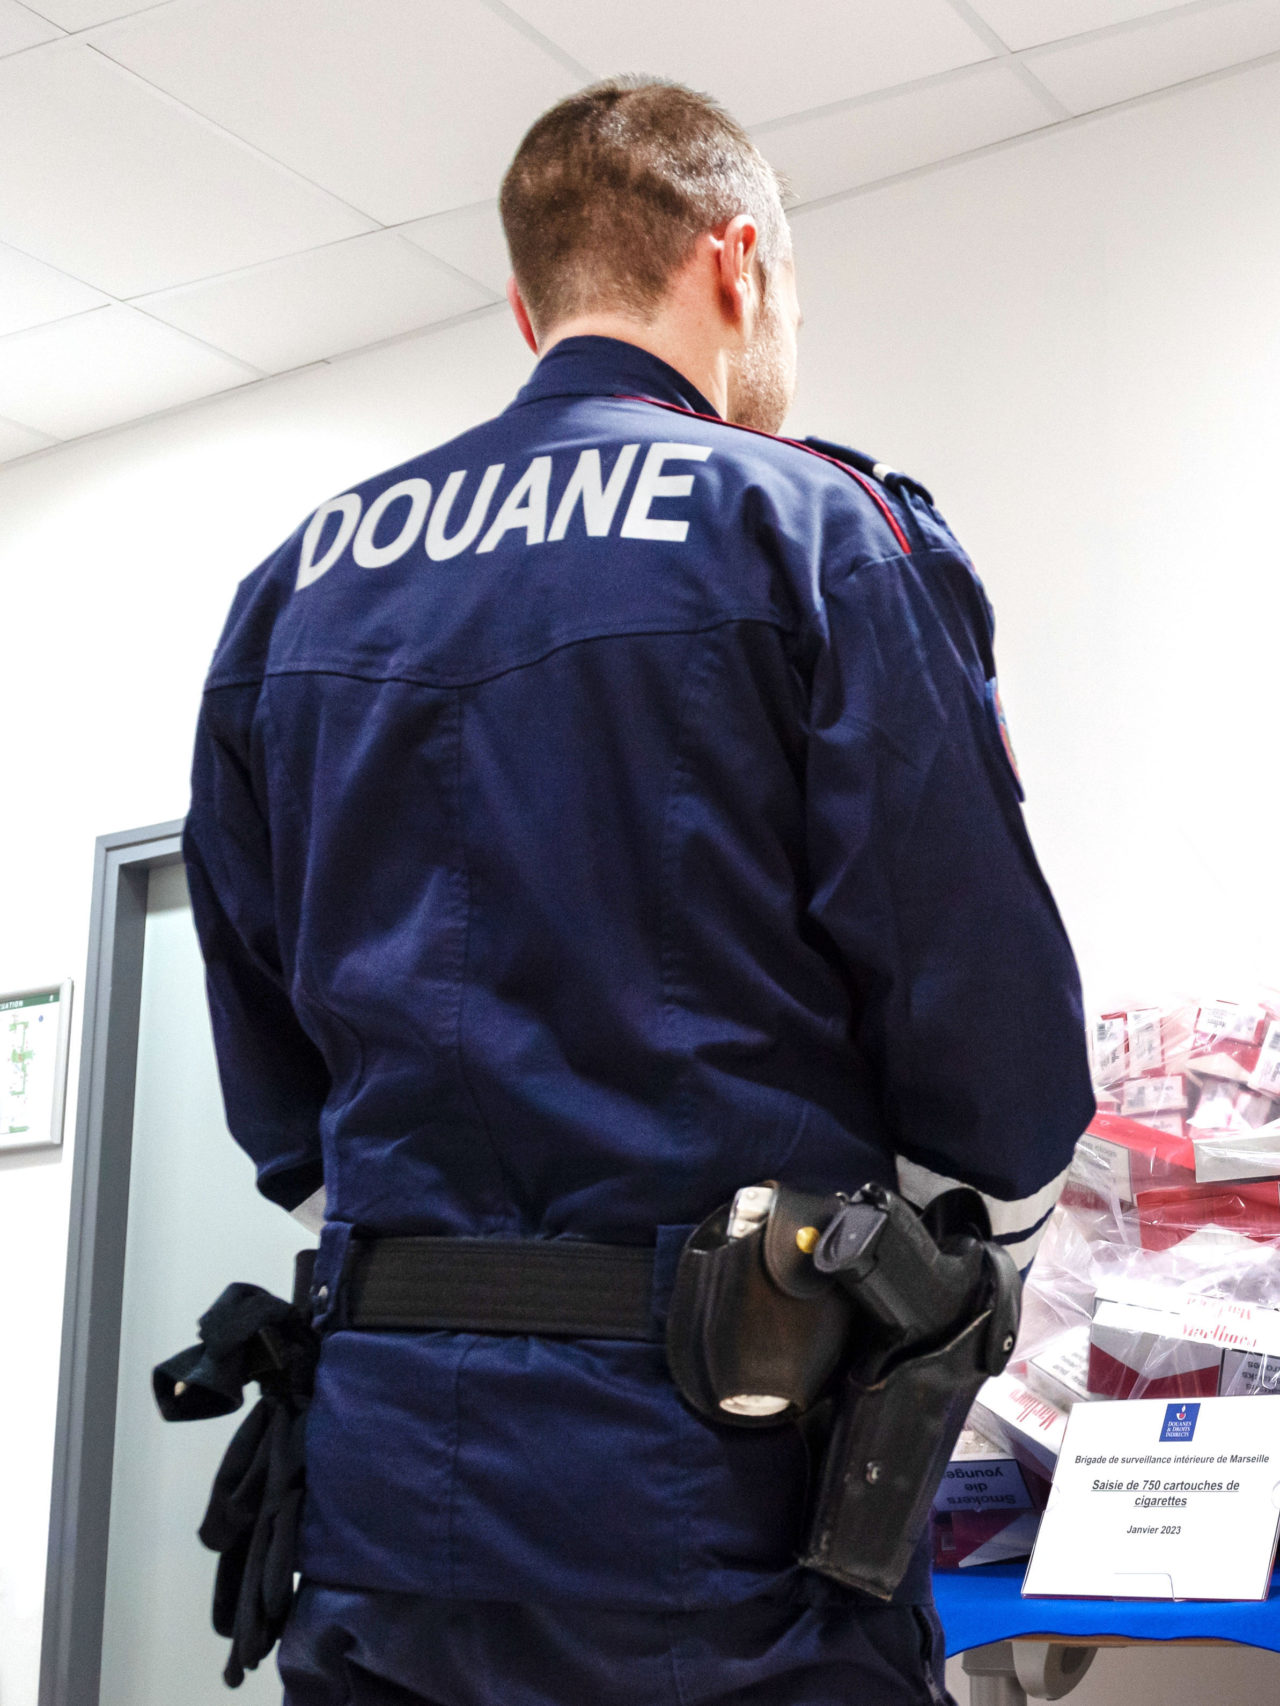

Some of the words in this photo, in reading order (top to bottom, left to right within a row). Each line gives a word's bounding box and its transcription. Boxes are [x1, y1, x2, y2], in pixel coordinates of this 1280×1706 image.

[295, 442, 713, 591] DOUANE
[1074, 1455, 1107, 1465] Brigade
[1109, 1455, 1119, 1464] de
[1121, 1455, 1172, 1464] surveillance
[1173, 1454, 1215, 1463] intérieure
[1217, 1454, 1227, 1463] de
[1229, 1454, 1270, 1463] Marseille
[946, 1466, 1004, 1479] younge
[964, 1482, 988, 1492] die
[1091, 1480, 1124, 1491] Saisie
[1126, 1480, 1139, 1491] de
[1142, 1480, 1161, 1491] 750
[1163, 1480, 1223, 1491] cartouches
[1226, 1480, 1240, 1491] de
[947, 1494, 1017, 1506] Smokers
[1134, 1495, 1188, 1508] cigarettes
[1126, 1525, 1159, 1535] Janvier
[1160, 1525, 1182, 1535] 2023
